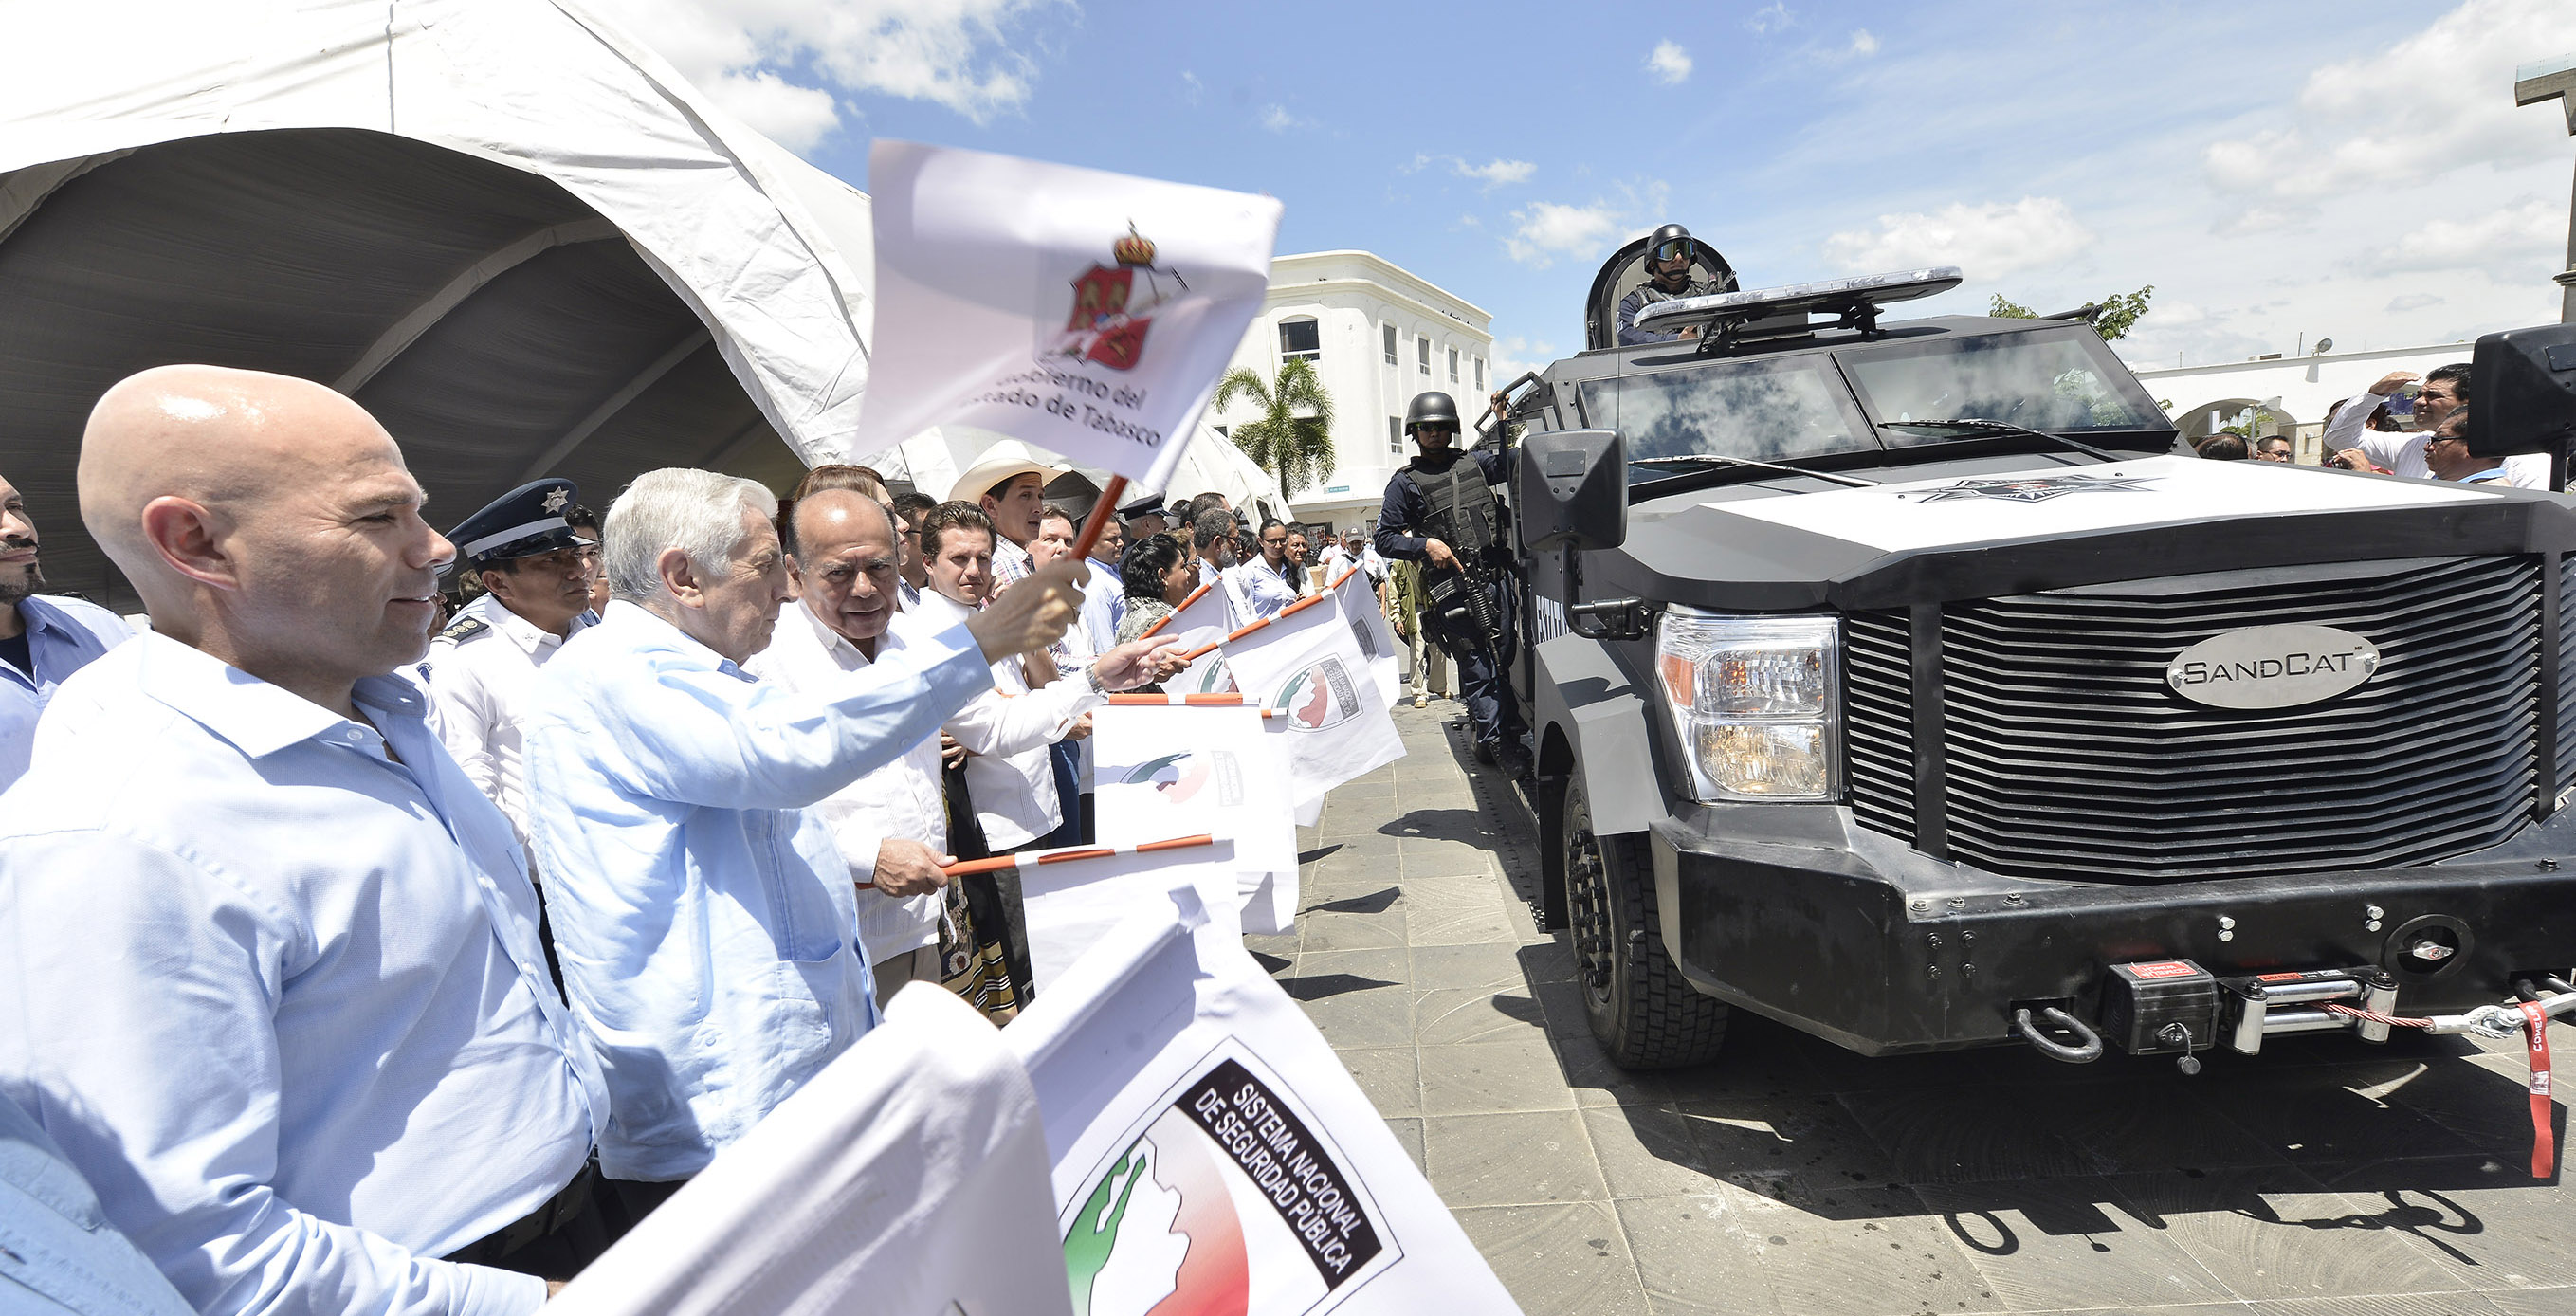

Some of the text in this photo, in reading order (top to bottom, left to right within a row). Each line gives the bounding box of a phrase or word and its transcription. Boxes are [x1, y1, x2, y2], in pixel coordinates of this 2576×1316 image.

[1046, 393, 1077, 421] de
[1083, 402, 1161, 448] Tabasco
[1112, 383, 1147, 411] del
[1536, 594, 1570, 644] ESTATA
[2526, 1005, 2542, 1051] COMEUP
[1195, 1088, 1352, 1275] DE SEGURIDAD PÚBLICA
[1233, 1082, 1361, 1239] SISTEMA NACIONAL
